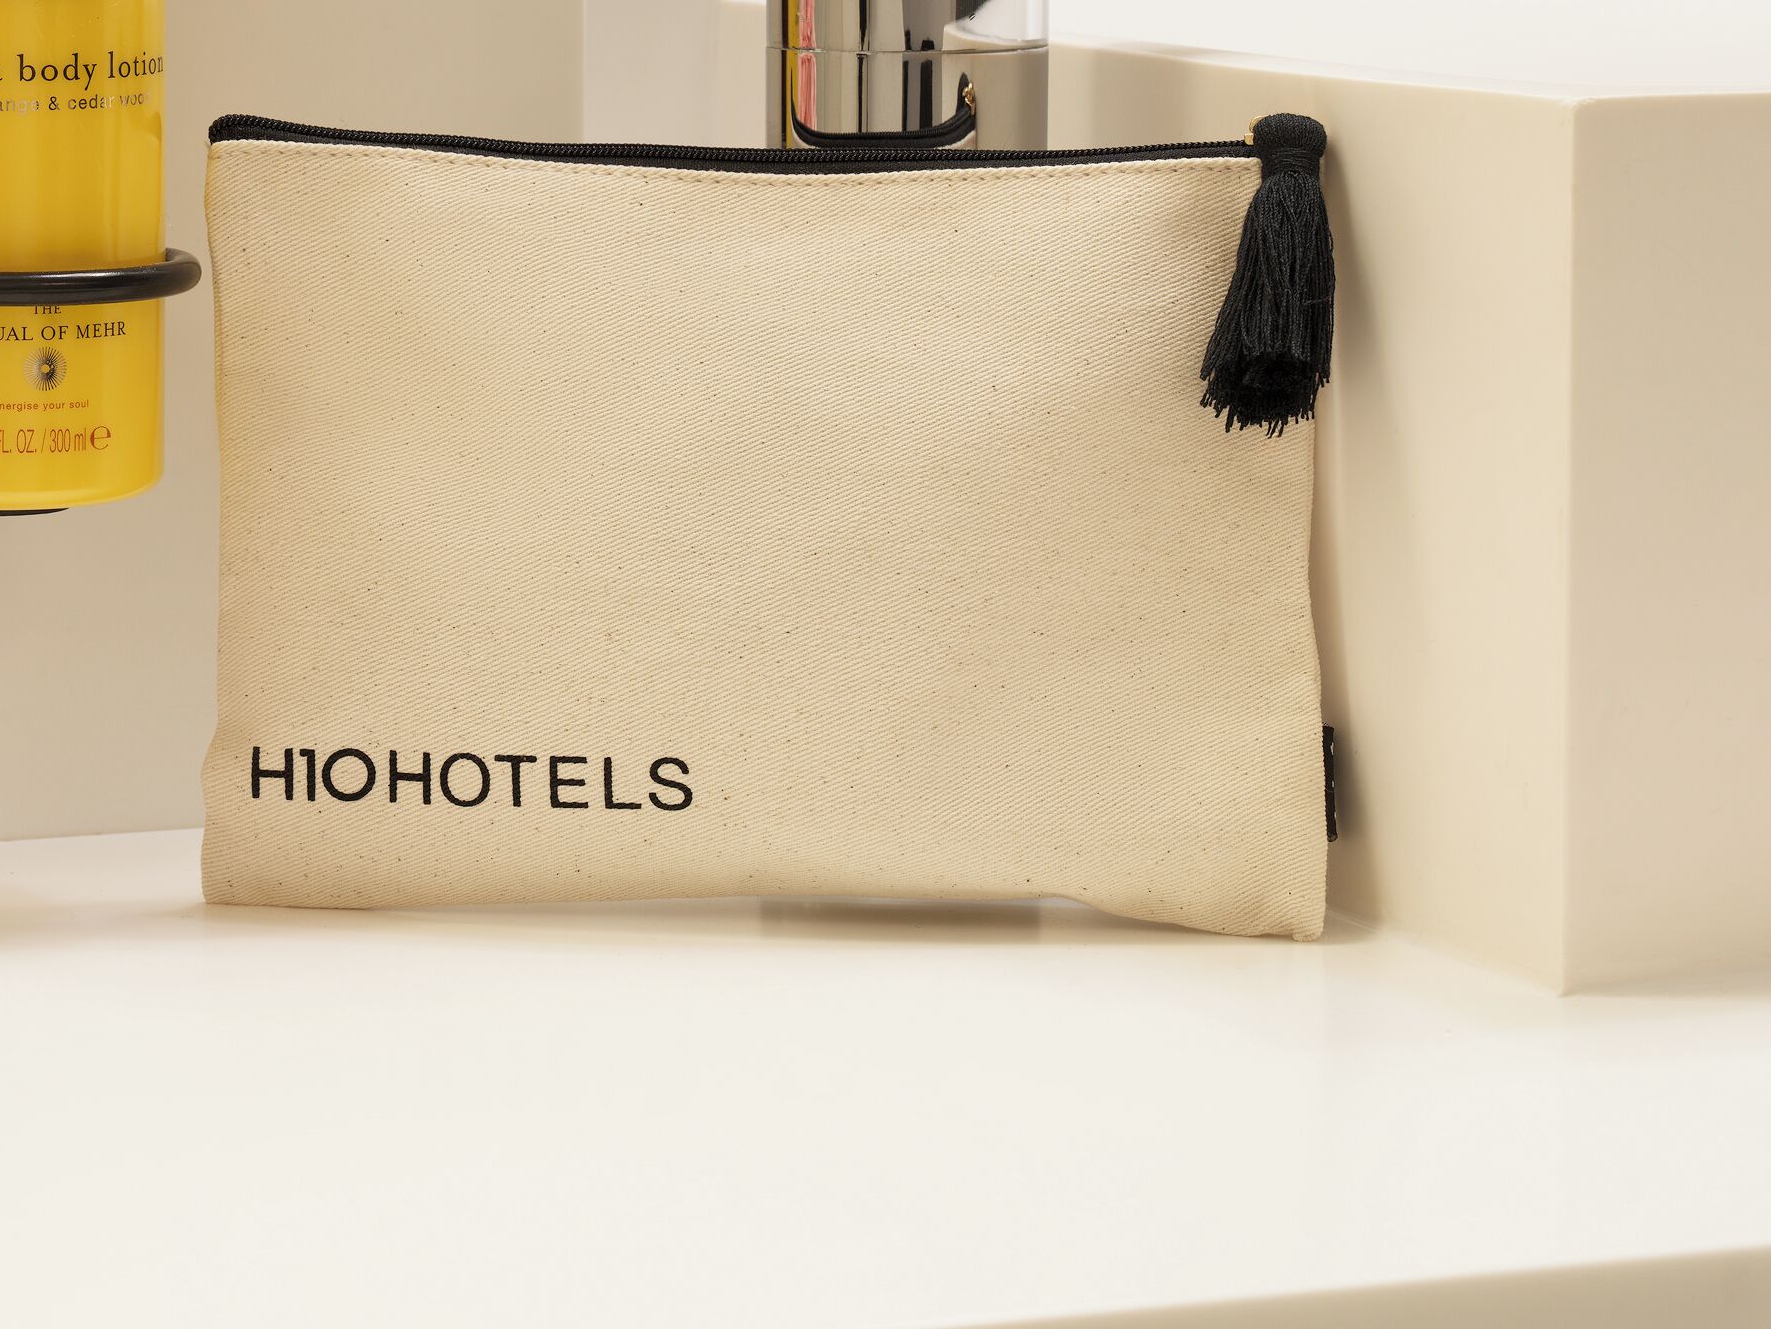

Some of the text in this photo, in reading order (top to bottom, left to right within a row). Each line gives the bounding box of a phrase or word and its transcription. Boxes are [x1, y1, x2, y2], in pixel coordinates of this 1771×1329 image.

[16, 52, 98, 91] body
[107, 51, 164, 79] lotion
[48, 96, 60, 111] &
[67, 94, 116, 111] cedar
[41, 325, 69, 341] OF
[76, 321, 127, 339] MEHR
[43, 401, 65, 412] your
[69, 399, 89, 409] soul
[16, 429, 37, 453] OZ.
[49, 428, 71, 453] 300
[74, 427, 86, 452] ml
